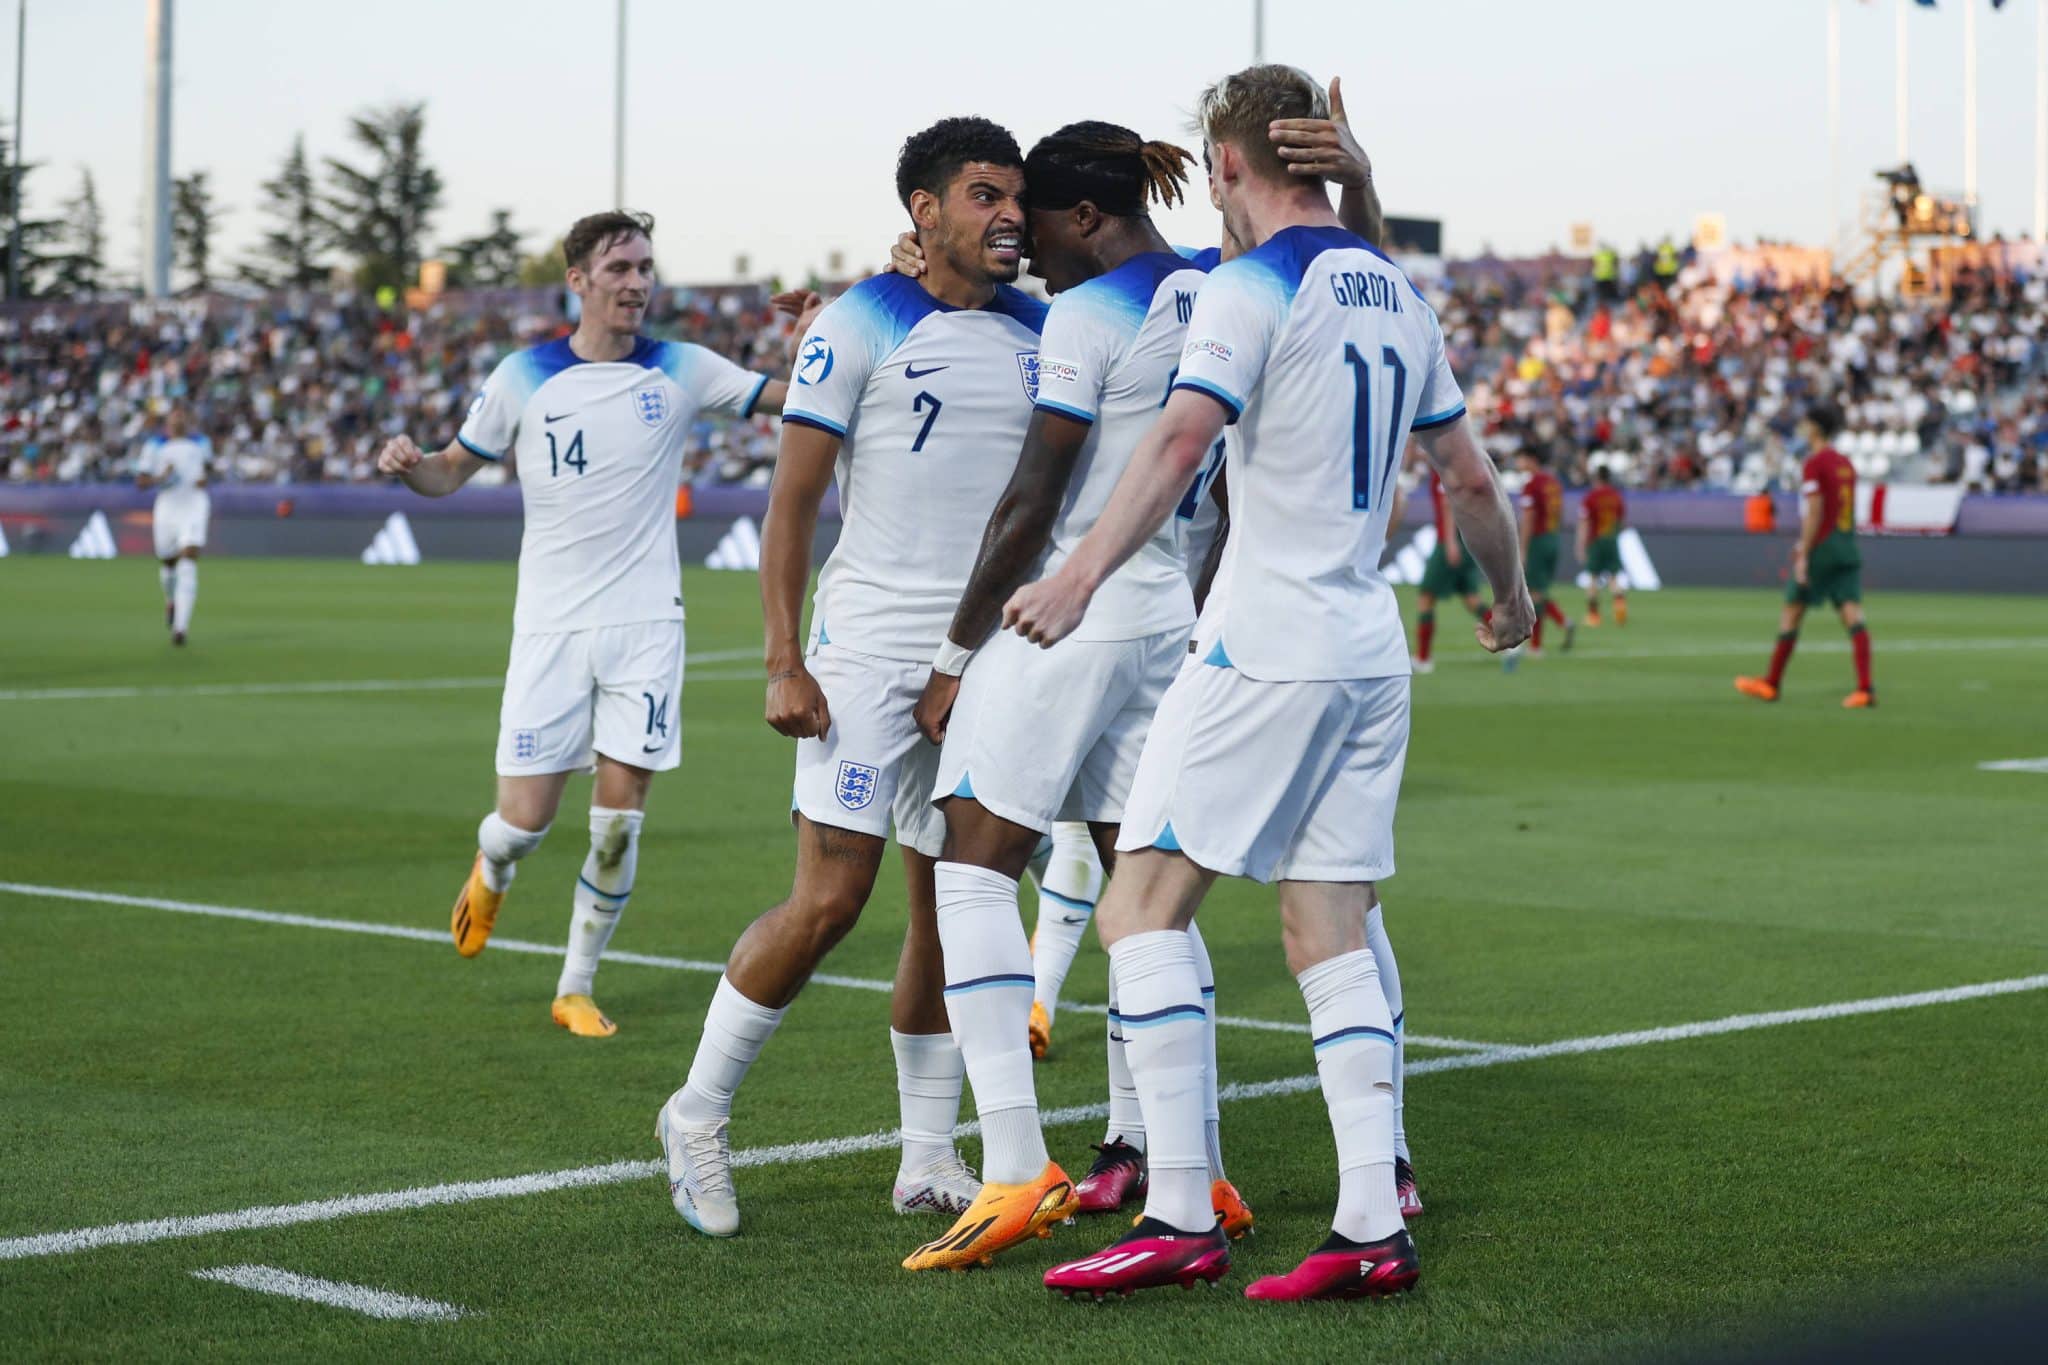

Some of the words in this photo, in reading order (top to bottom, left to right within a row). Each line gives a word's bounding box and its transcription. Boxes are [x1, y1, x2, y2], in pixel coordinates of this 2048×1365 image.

[911, 390, 943, 452] 7
[1344, 343, 1407, 513] 11
[545, 429, 588, 477] 14
[643, 692, 667, 738] 14
